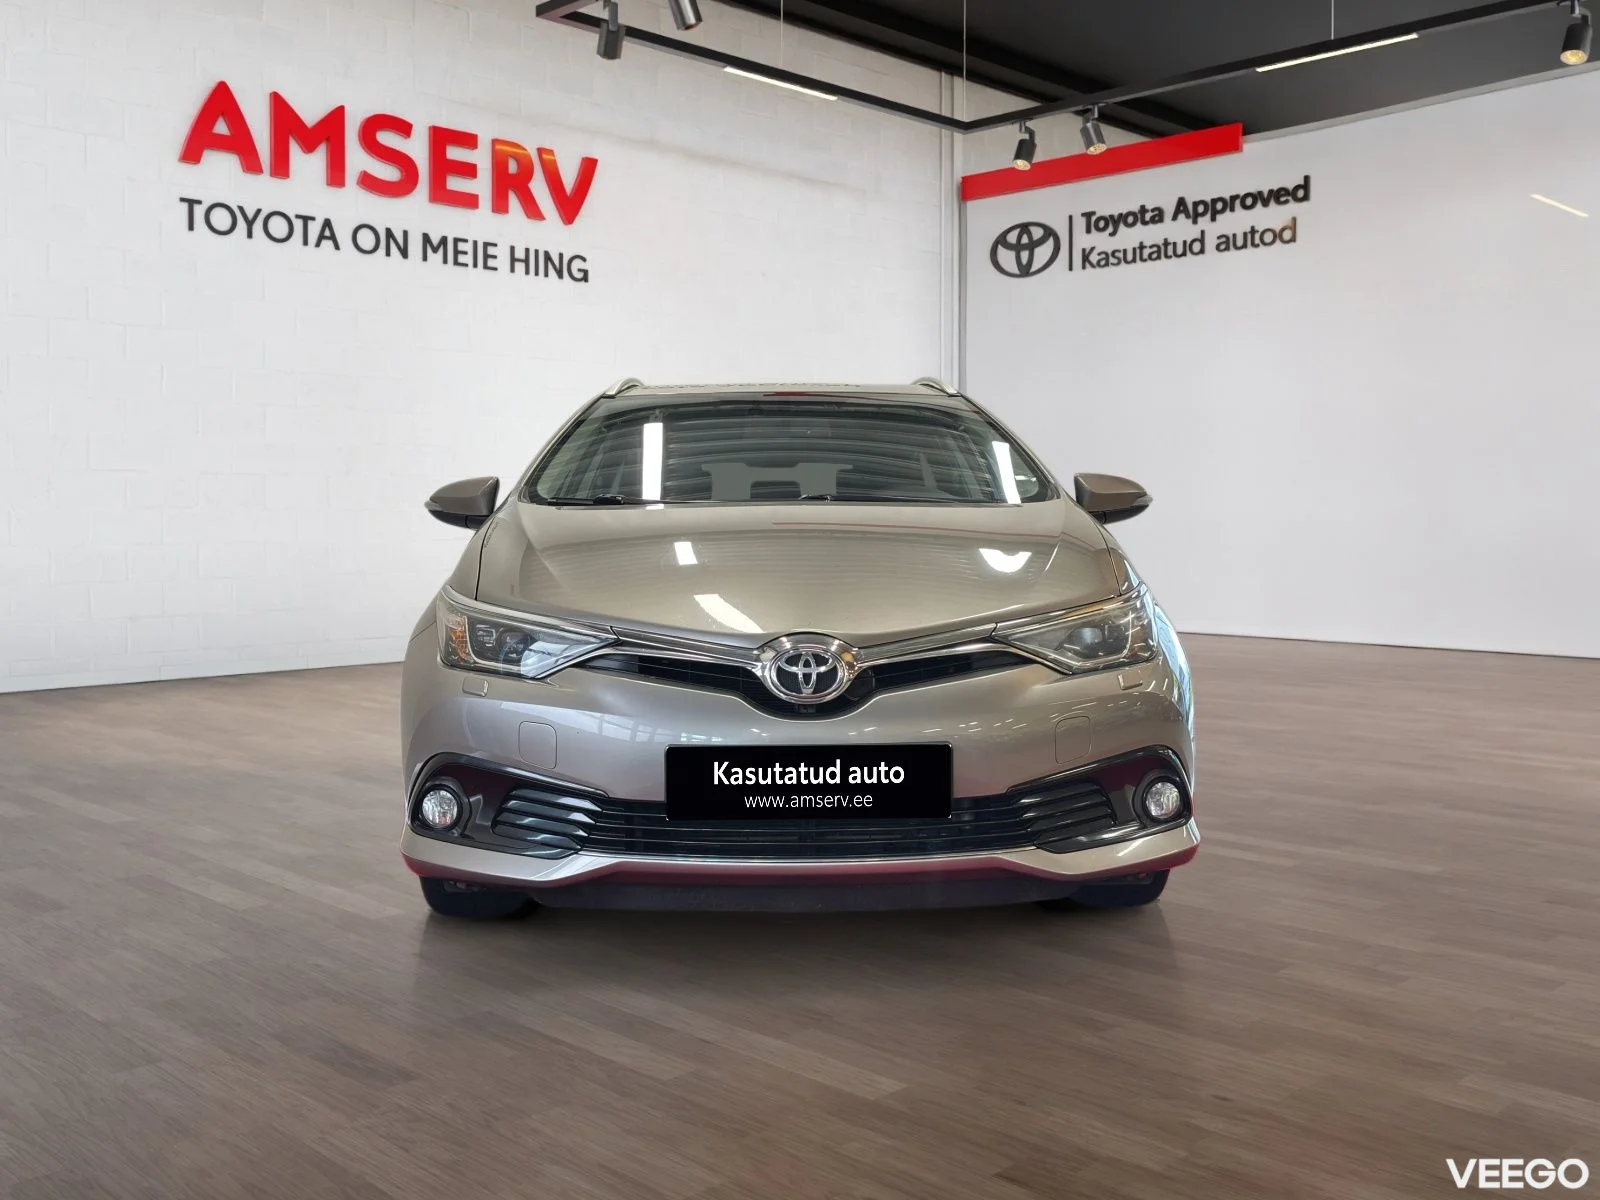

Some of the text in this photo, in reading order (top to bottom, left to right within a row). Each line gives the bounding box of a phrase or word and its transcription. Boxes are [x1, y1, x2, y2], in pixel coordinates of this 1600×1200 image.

[178, 80, 598, 225] AMSERV
[1081, 175, 1311, 236] Toyota Approved
[179, 197, 590, 283] TOYOTA ON MEIE HING
[1081, 216, 1297, 270] Kasutatud autod
[713, 759, 905, 785] Kasutatud auto
[744, 794, 873, 808] www.amserv.ee
